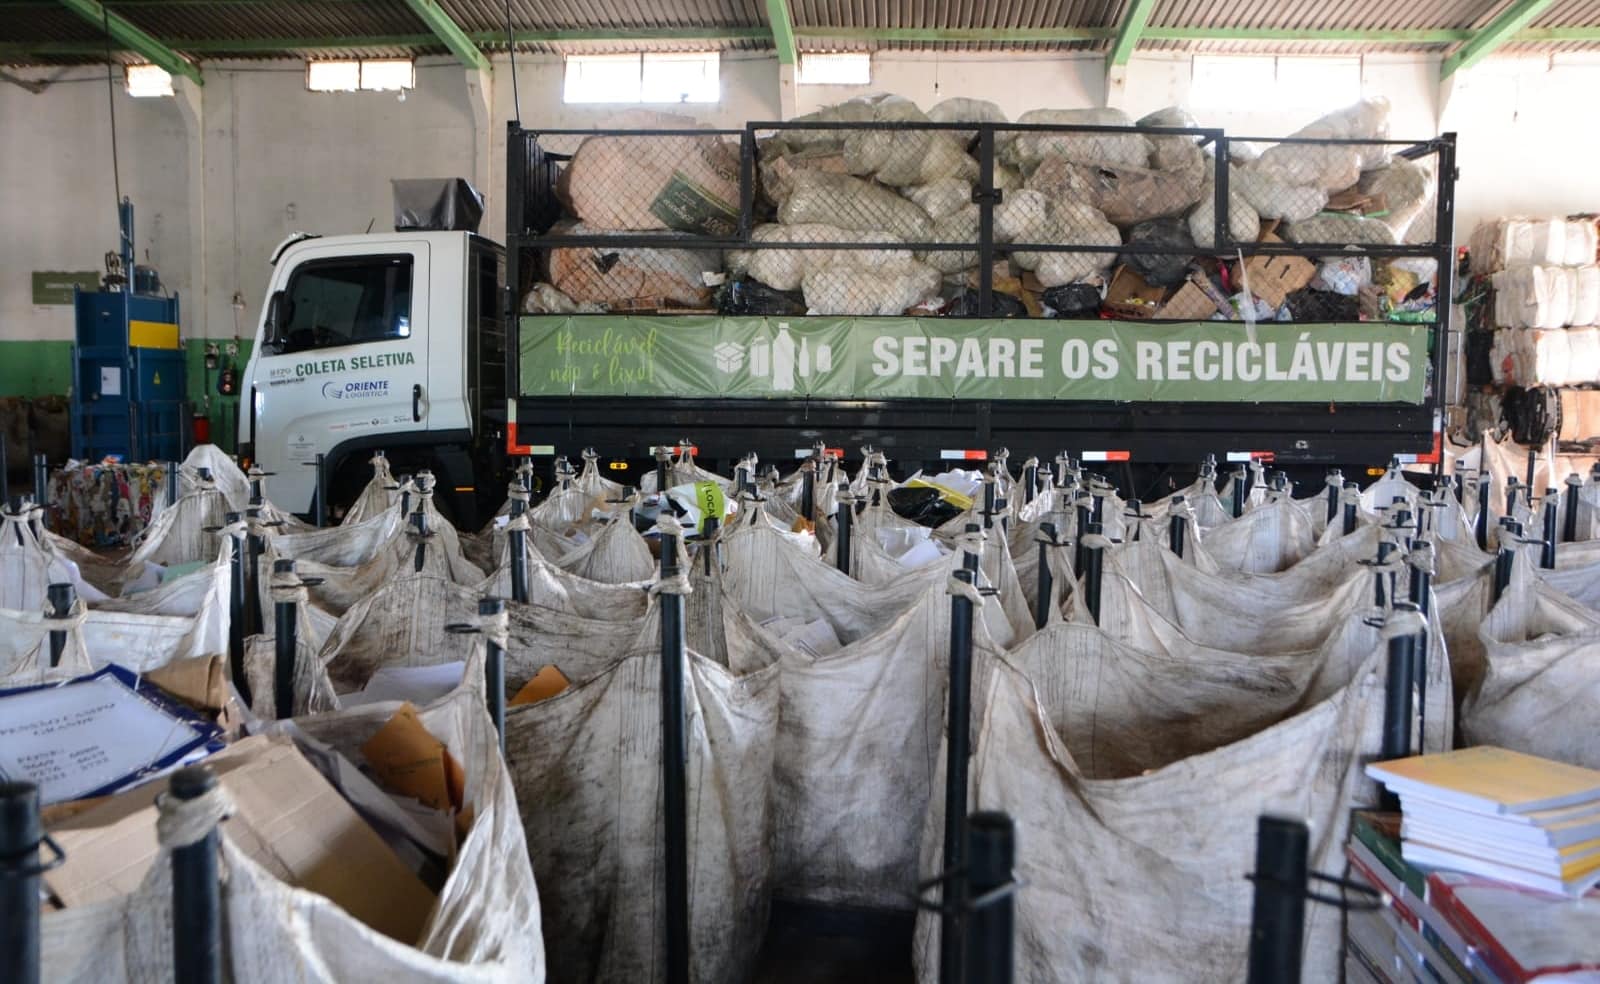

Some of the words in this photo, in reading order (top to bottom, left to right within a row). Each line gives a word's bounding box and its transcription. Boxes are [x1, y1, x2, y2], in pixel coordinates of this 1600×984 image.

[557, 328, 657, 357] Reciclável
[296, 359, 346, 377] COLETA
[351, 352, 416, 370] SELETIVA
[871, 335, 1044, 379] SEPARE
[1061, 338, 1120, 380] OS
[1136, 332, 1411, 382] RECICLÁVEIS
[345, 380, 389, 392] ORIENTE
[550, 365, 581, 384] não
